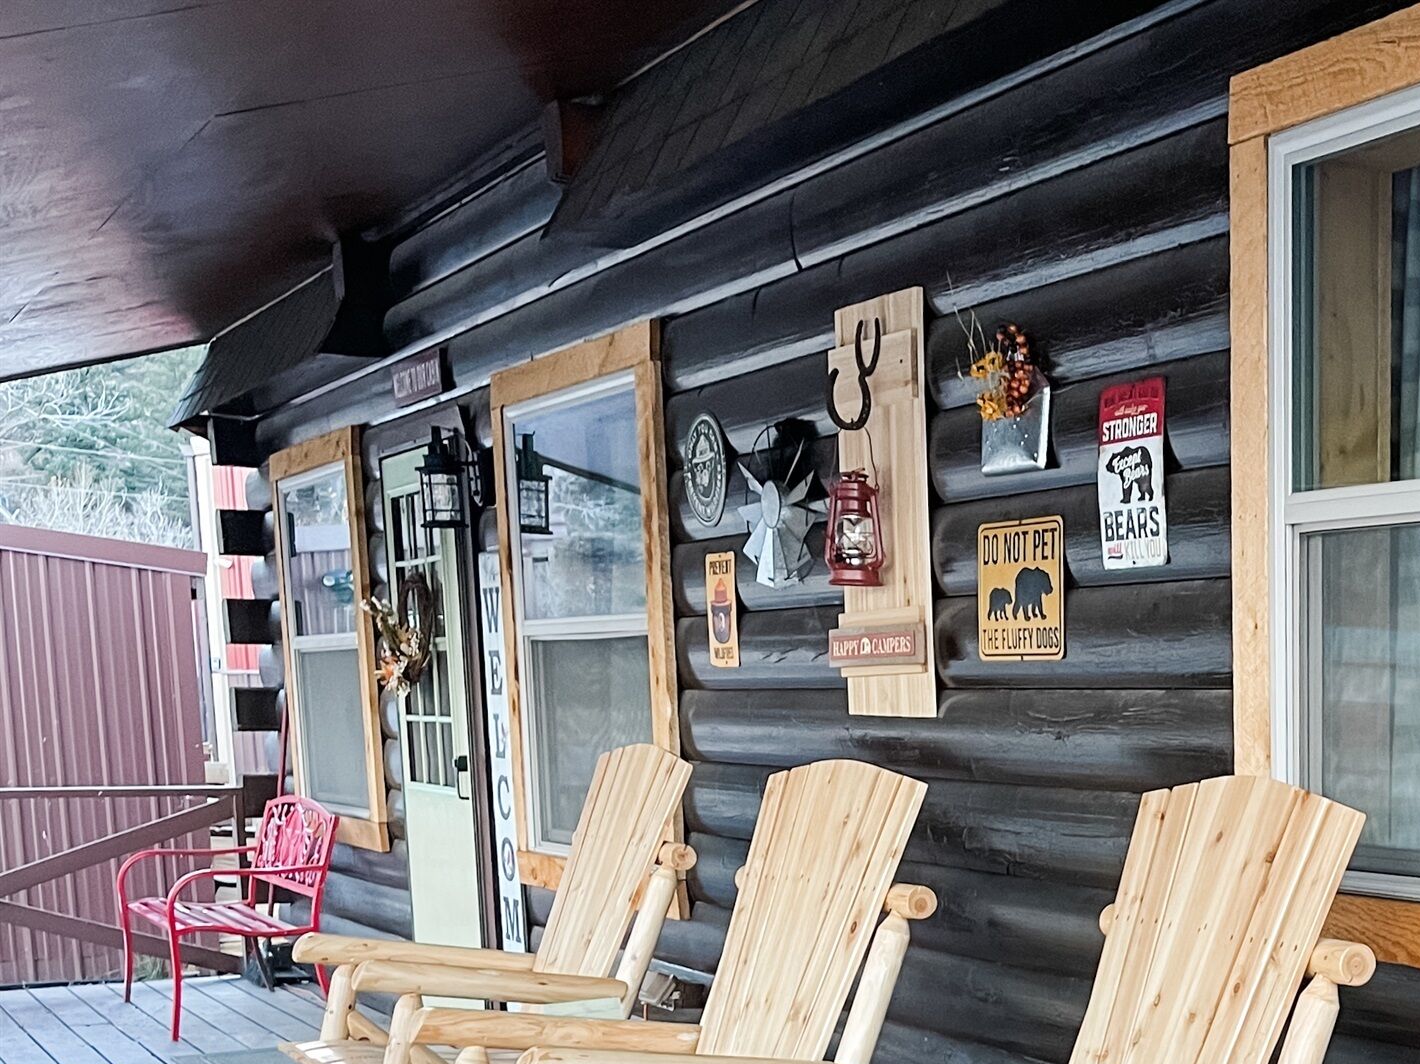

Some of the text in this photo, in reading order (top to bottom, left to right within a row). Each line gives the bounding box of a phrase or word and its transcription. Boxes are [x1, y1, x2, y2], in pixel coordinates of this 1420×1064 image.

[1102, 412, 1158, 442] STRONGER
[1111, 449, 1142, 474] Except
[1122, 464, 1150, 489] Bears
[1103, 506, 1160, 542] BEARS
[983, 527, 1057, 565] DO NOT PET
[1124, 540, 1144, 560] KILL
[1144, 538, 1161, 558] YOU
[832, 636, 912, 657] HAPPY CAMPERS
[983, 627, 1059, 650] THE FLUFFY DOGS
[482, 587, 521, 943] WELCOM
